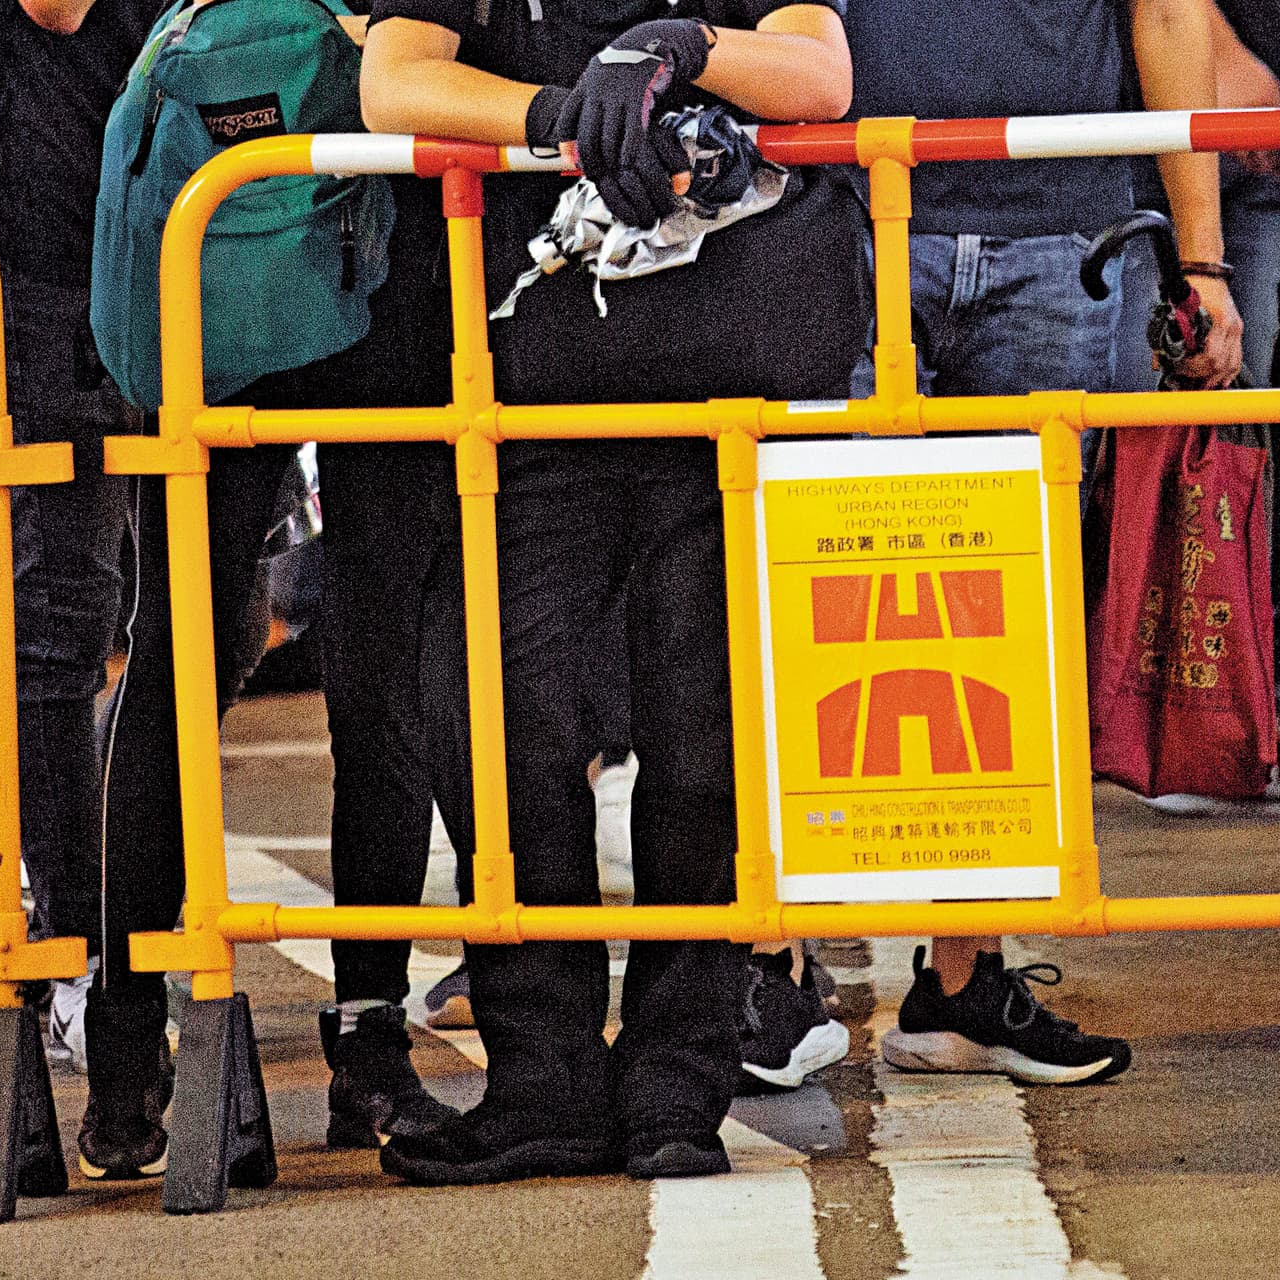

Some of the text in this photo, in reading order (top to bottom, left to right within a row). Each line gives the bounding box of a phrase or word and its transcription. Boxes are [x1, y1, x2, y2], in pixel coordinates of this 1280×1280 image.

[787, 477, 1016, 497] HIGHWAYS DEPARTMENT
[837, 496, 969, 514] URBAN REGION
[845, 513, 963, 531] (HONG KONG)
[816, 535, 874, 553] 路政署
[887, 533, 926, 550] 市區
[901, 850, 944, 864] 8100
[949, 848, 991, 862] 9988
